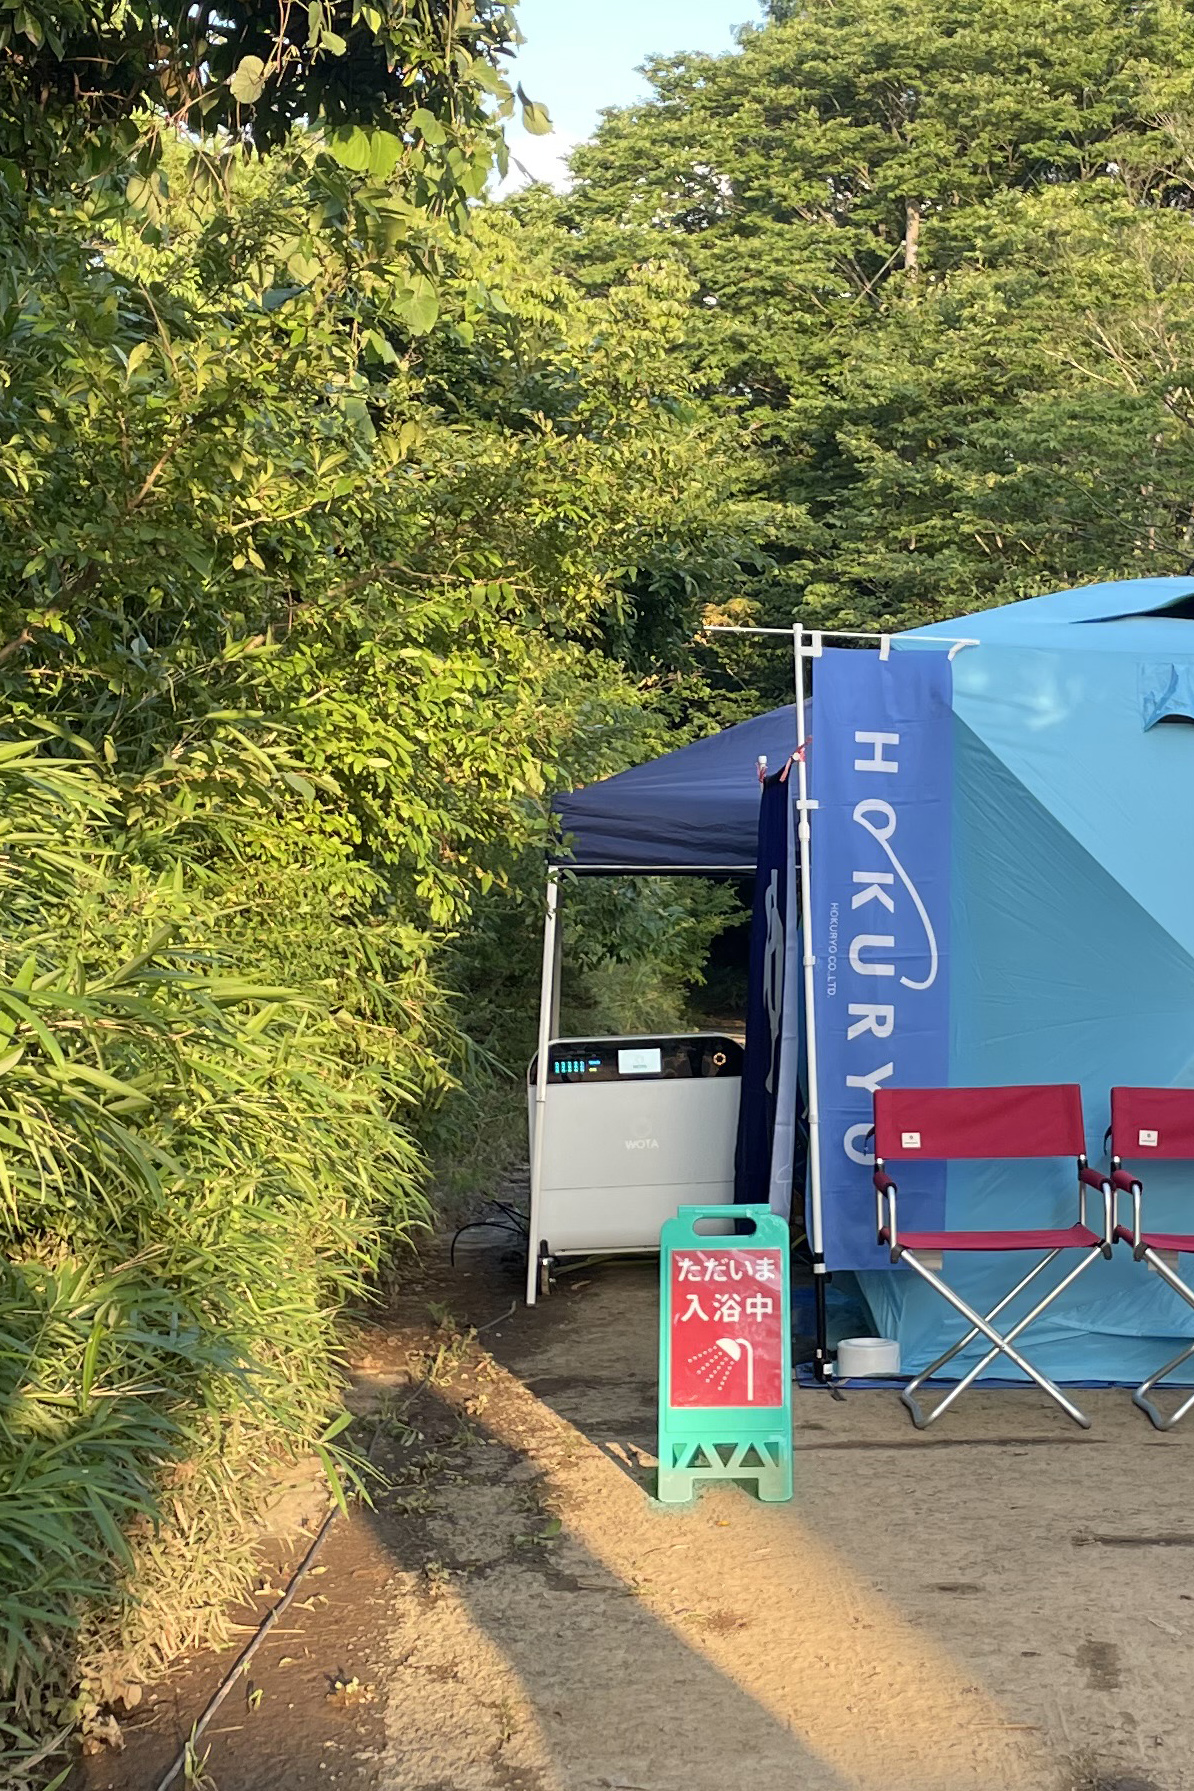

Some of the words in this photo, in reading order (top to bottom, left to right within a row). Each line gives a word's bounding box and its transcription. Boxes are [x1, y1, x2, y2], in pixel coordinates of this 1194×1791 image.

[828, 902, 839, 954] HOKURYO
[843, 730, 938, 1167] HOKURYO
[624, 1138, 660, 1151] WOTA
[678, 1256, 775, 1282] ただいま
[681, 1292, 773, 1323] 入浴中
